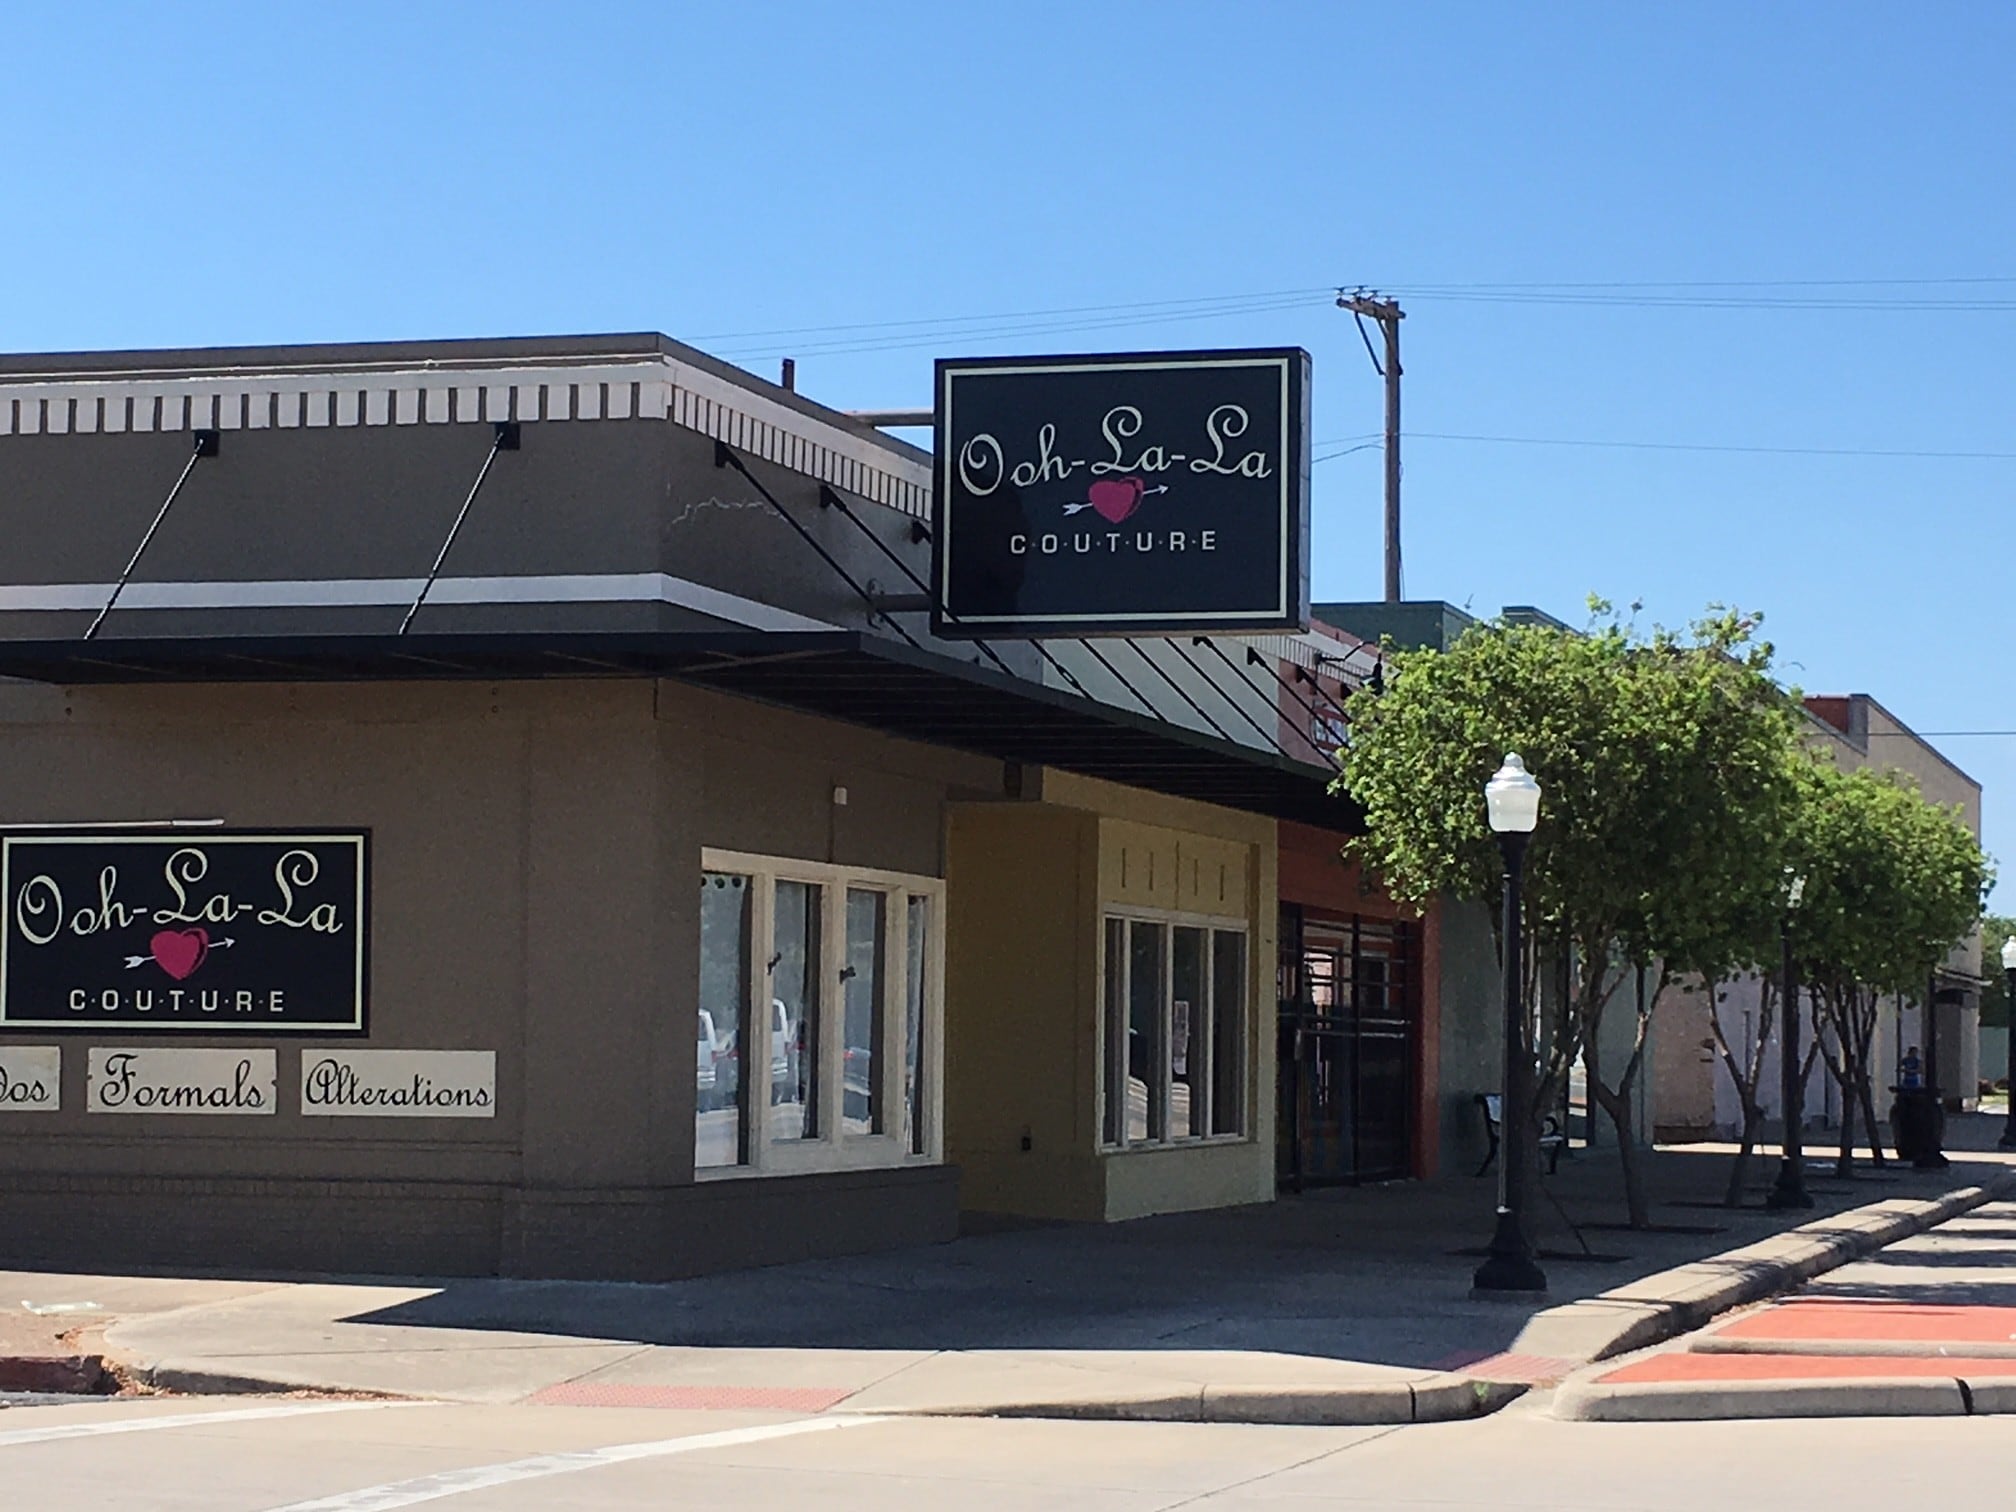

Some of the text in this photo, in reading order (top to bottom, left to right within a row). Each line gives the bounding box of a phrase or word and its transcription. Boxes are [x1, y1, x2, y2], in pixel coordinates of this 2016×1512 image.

[958, 404, 1272, 497] Ooh-La-La
[15, 847, 344, 945] Ooh-La-La
[98, 1052, 266, 1108] Formals
[304, 1057, 493, 1108] Alterations
